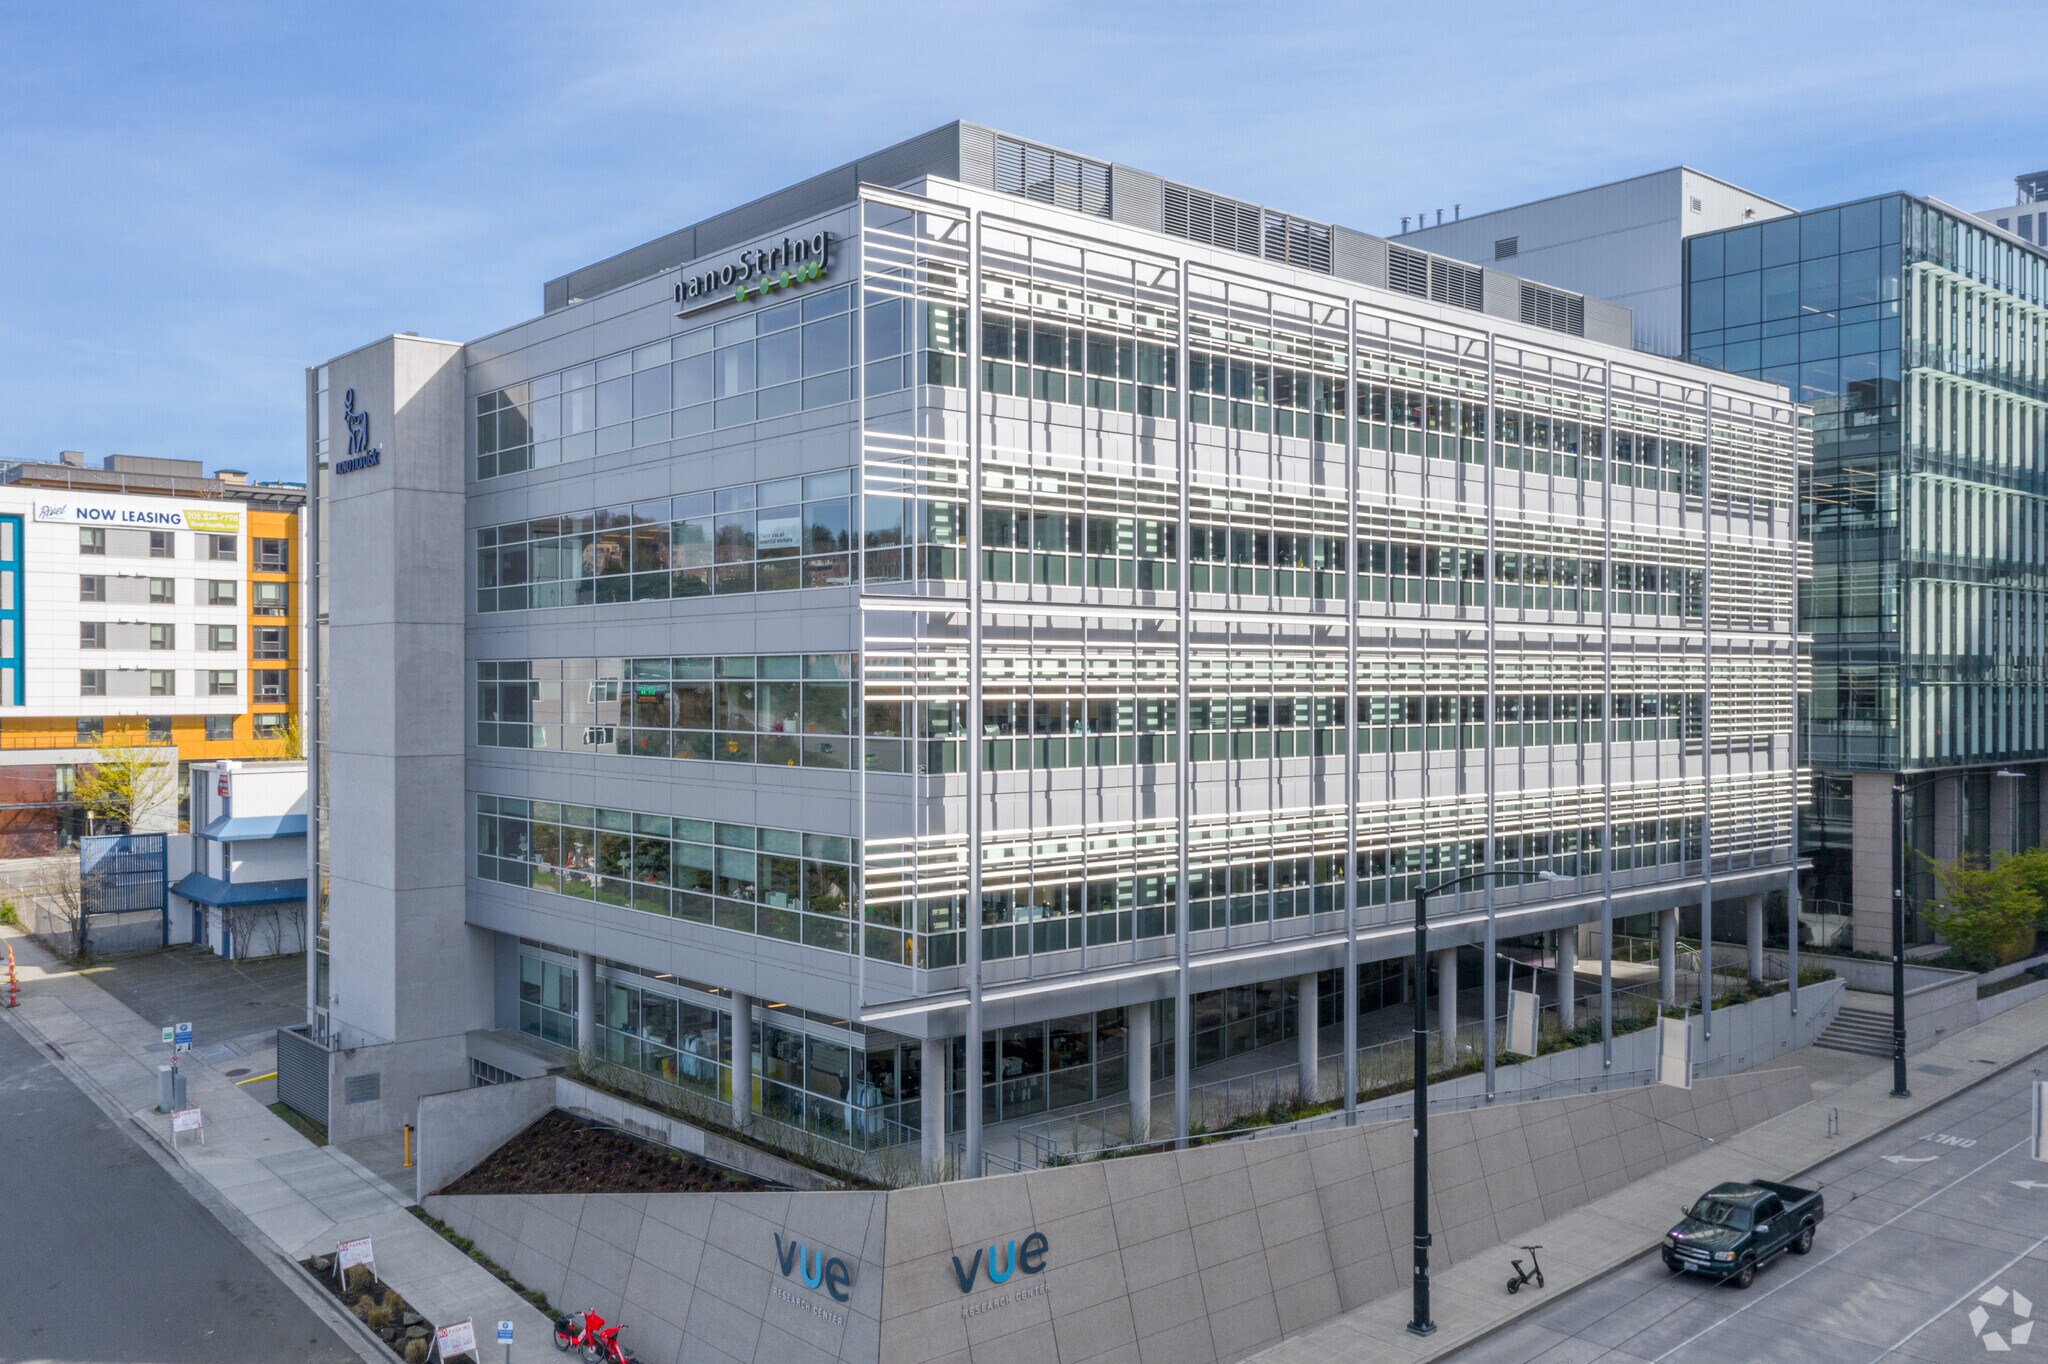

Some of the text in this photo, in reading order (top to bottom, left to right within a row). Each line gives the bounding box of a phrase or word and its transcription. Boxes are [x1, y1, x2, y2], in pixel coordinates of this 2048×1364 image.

[673, 231, 828, 302] nanoString
[76, 507, 182, 525] NOW LEASING
[774, 1287, 844, 1326] RESEARCH CENTER
[962, 1283, 1050, 1319] RESEARCH CENTER
[437, 1327, 448, 1338] NO
[448, 1323, 471, 1335] PARKING
